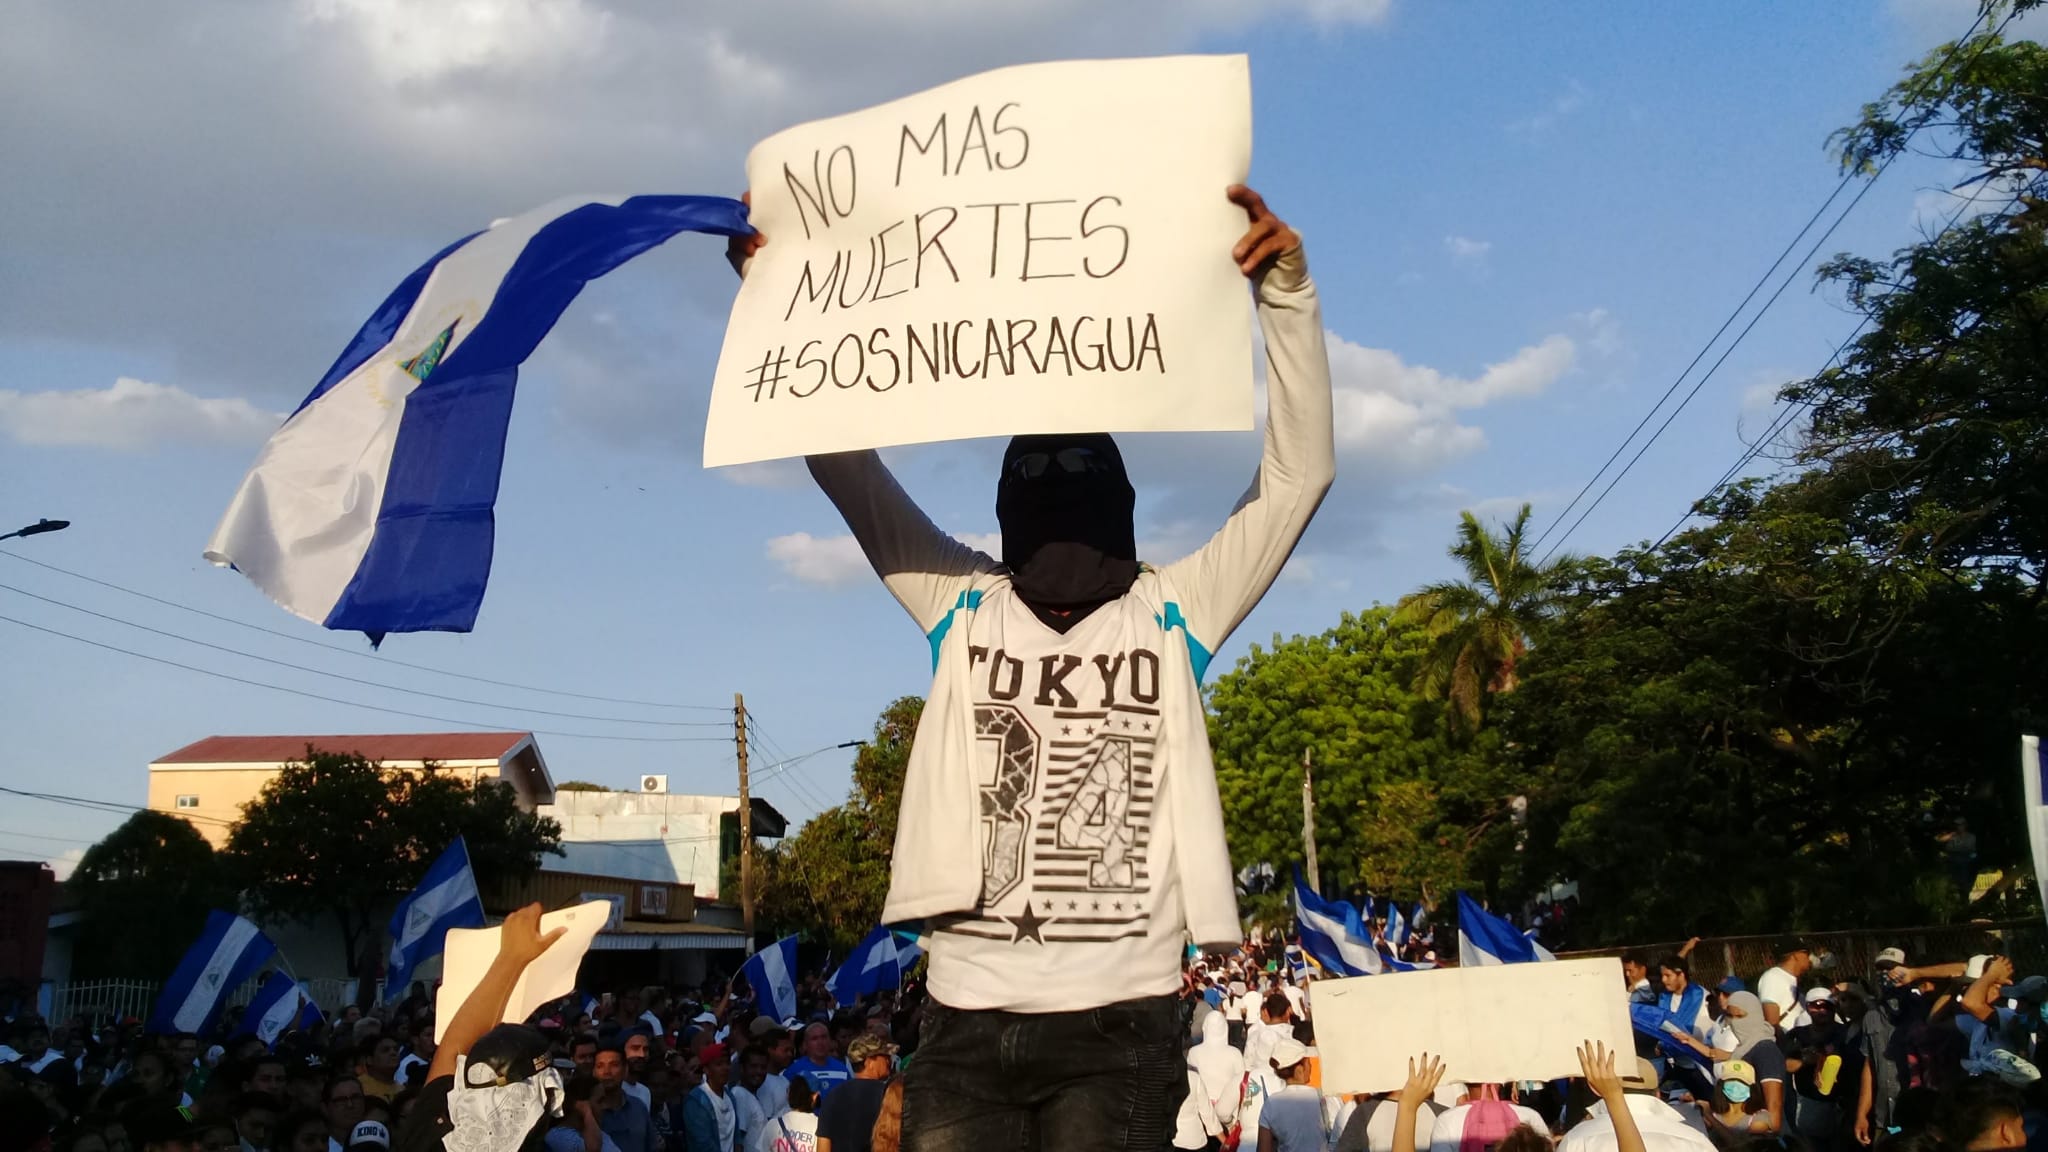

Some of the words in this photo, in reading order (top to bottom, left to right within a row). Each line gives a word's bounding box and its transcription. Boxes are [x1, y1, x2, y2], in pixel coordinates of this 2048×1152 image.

[783, 144, 857, 240] NO
[894, 102, 1030, 188] MAS
[783, 195, 1130, 322] MUERTES
[743, 312, 1166, 403] #SOSNICARAGUA
[782, 1129, 813, 1145] ODER
